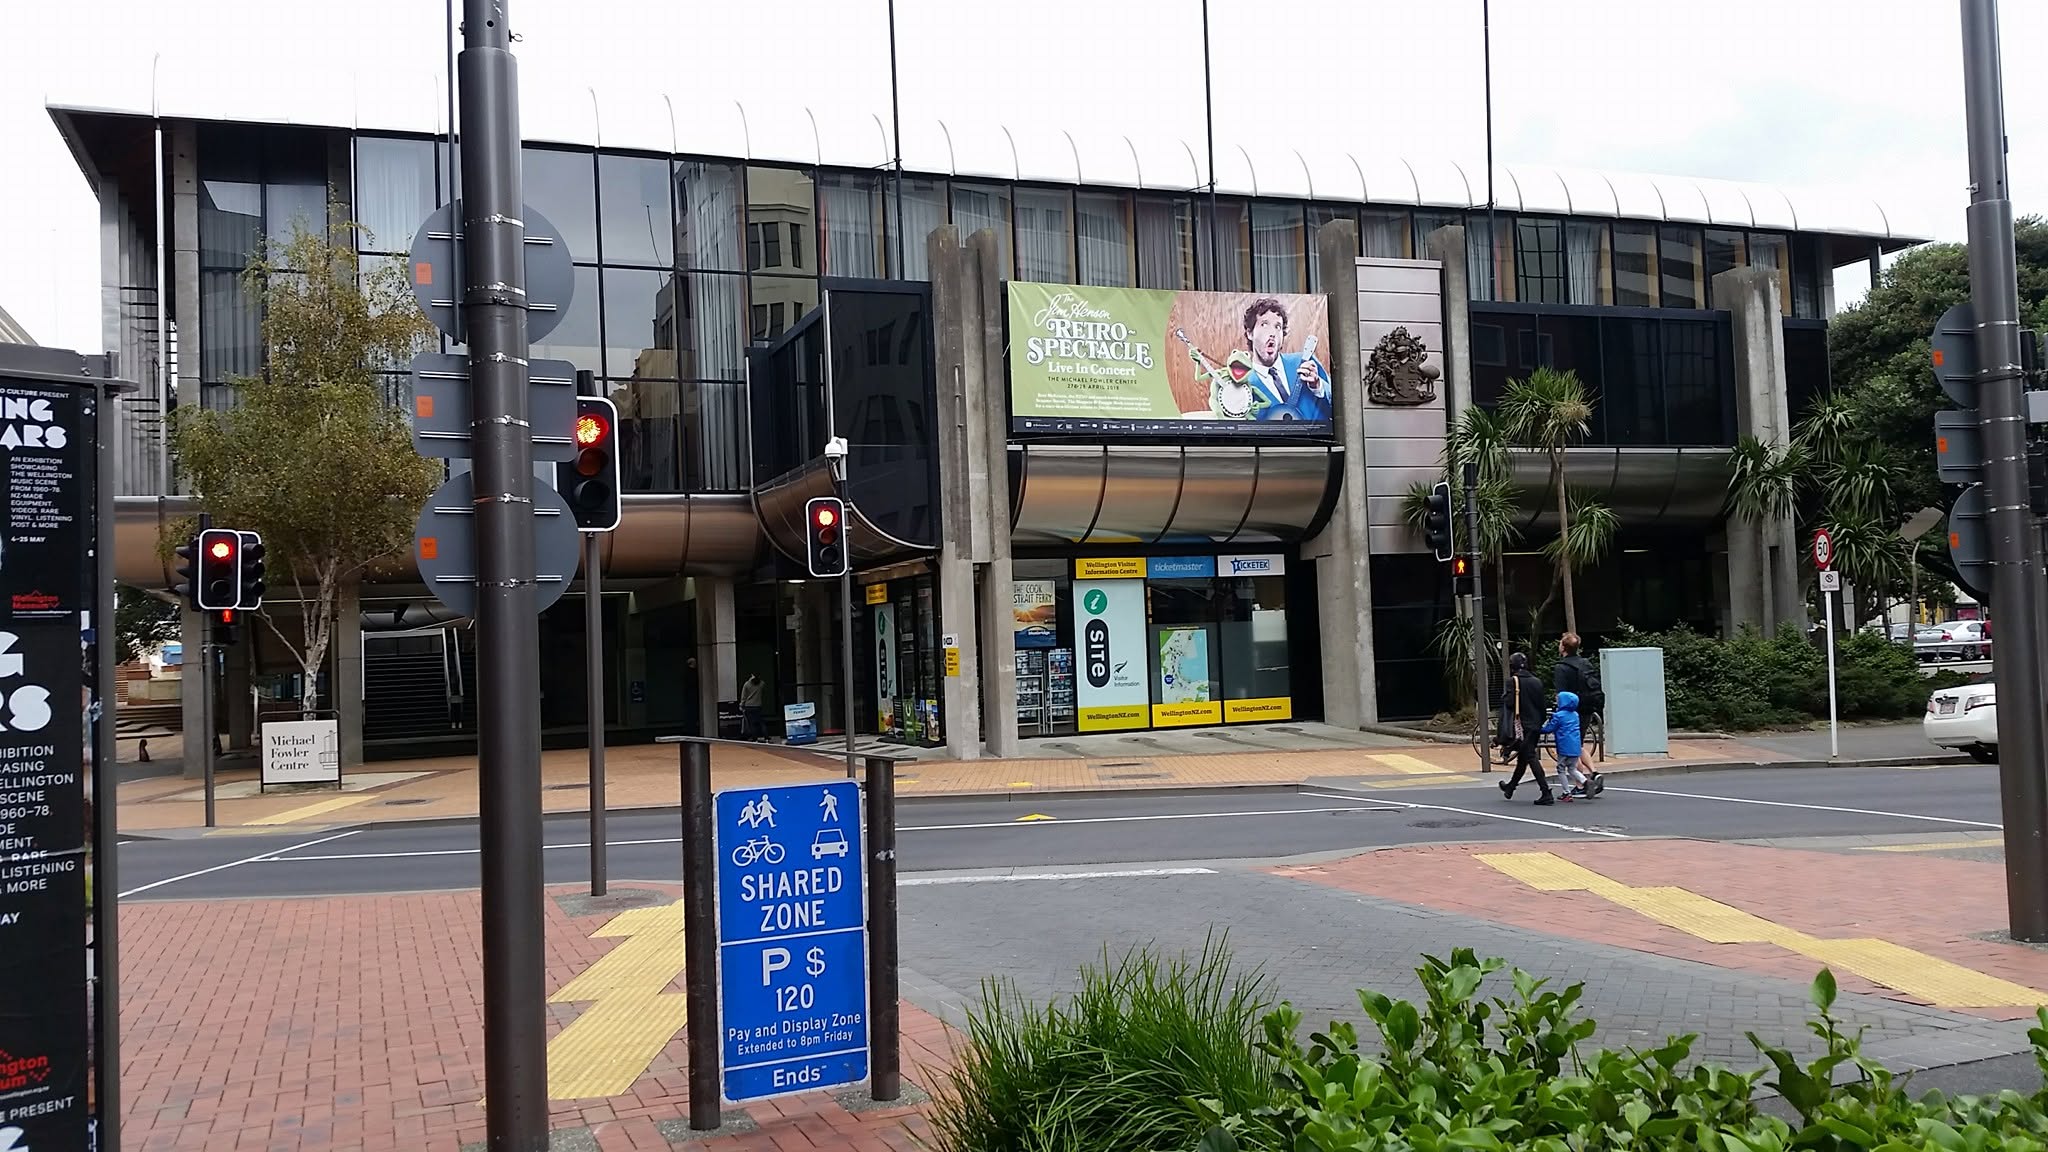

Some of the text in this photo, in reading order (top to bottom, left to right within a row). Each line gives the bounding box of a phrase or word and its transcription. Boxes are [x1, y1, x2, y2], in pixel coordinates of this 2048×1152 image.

[1034, 294, 1111, 327] Jim Henson
[1026, 337, 1154, 369] SPECTACLE
[1048, 362, 1136, 376] Live In Concert
[6, 388, 38, 396] CULTURE
[0, 396, 53, 422] NG
[10, 463, 58, 471] SHOWCASING
[26, 471, 73, 479] WELLINGTON
[1817, 541, 1827, 557] 50
[1155, 562, 1203, 572] ticketmaster
[1232, 561, 1268, 571] TICKETEK
[1025, 584, 1043, 594] COOK
[1013, 594, 1034, 603] STRAIT
[1087, 712, 1140, 720] WellingtonNZ.com
[1161, 708, 1212, 717] WellingtonNZ.com
[1232, 704, 1282, 713] WellingtonNZ.com
[271, 734, 315, 746] Michael
[271, 747, 309, 759] Fowler
[271, 760, 309, 771] Centre
[1, 860, 76, 879] LISTENING
[6, 878, 48, 894] MORE
[741, 866, 842, 902] SHARED
[760, 899, 826, 932] ZONE
[762, 947, 791, 986] P
[776, 983, 814, 1012] 120
[729, 1013, 861, 1042] Pay and Display Zone
[738, 1030, 853, 1055] Extended to 8pm Friday
[773, 1064, 821, 1088] Ends
[9, 1096, 75, 1121] PRESENT
